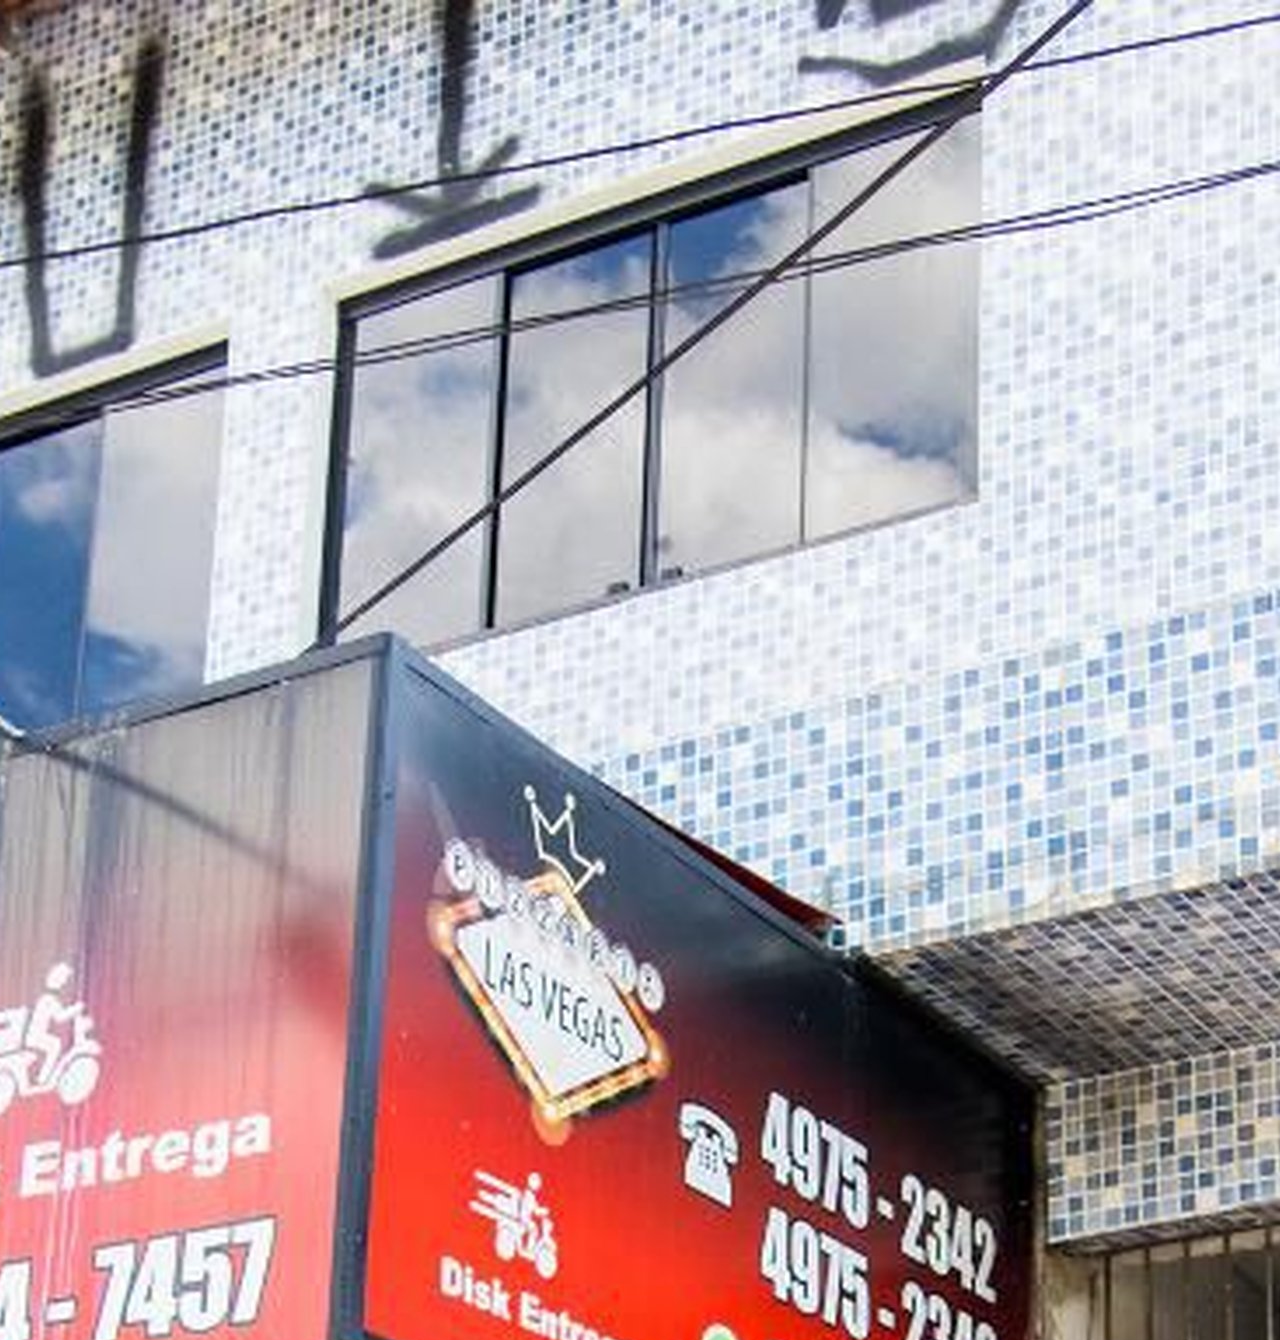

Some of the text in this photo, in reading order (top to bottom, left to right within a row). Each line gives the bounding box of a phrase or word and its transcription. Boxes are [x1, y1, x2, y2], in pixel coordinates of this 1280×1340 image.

[486, 938, 624, 1062] LAS VEGAS
[19, 1112, 272, 1195] Entrega
[761, 1090, 869, 1230] 4975
[900, 1173, 997, 1304] 2342
[439, 1255, 512, 1322] Disk
